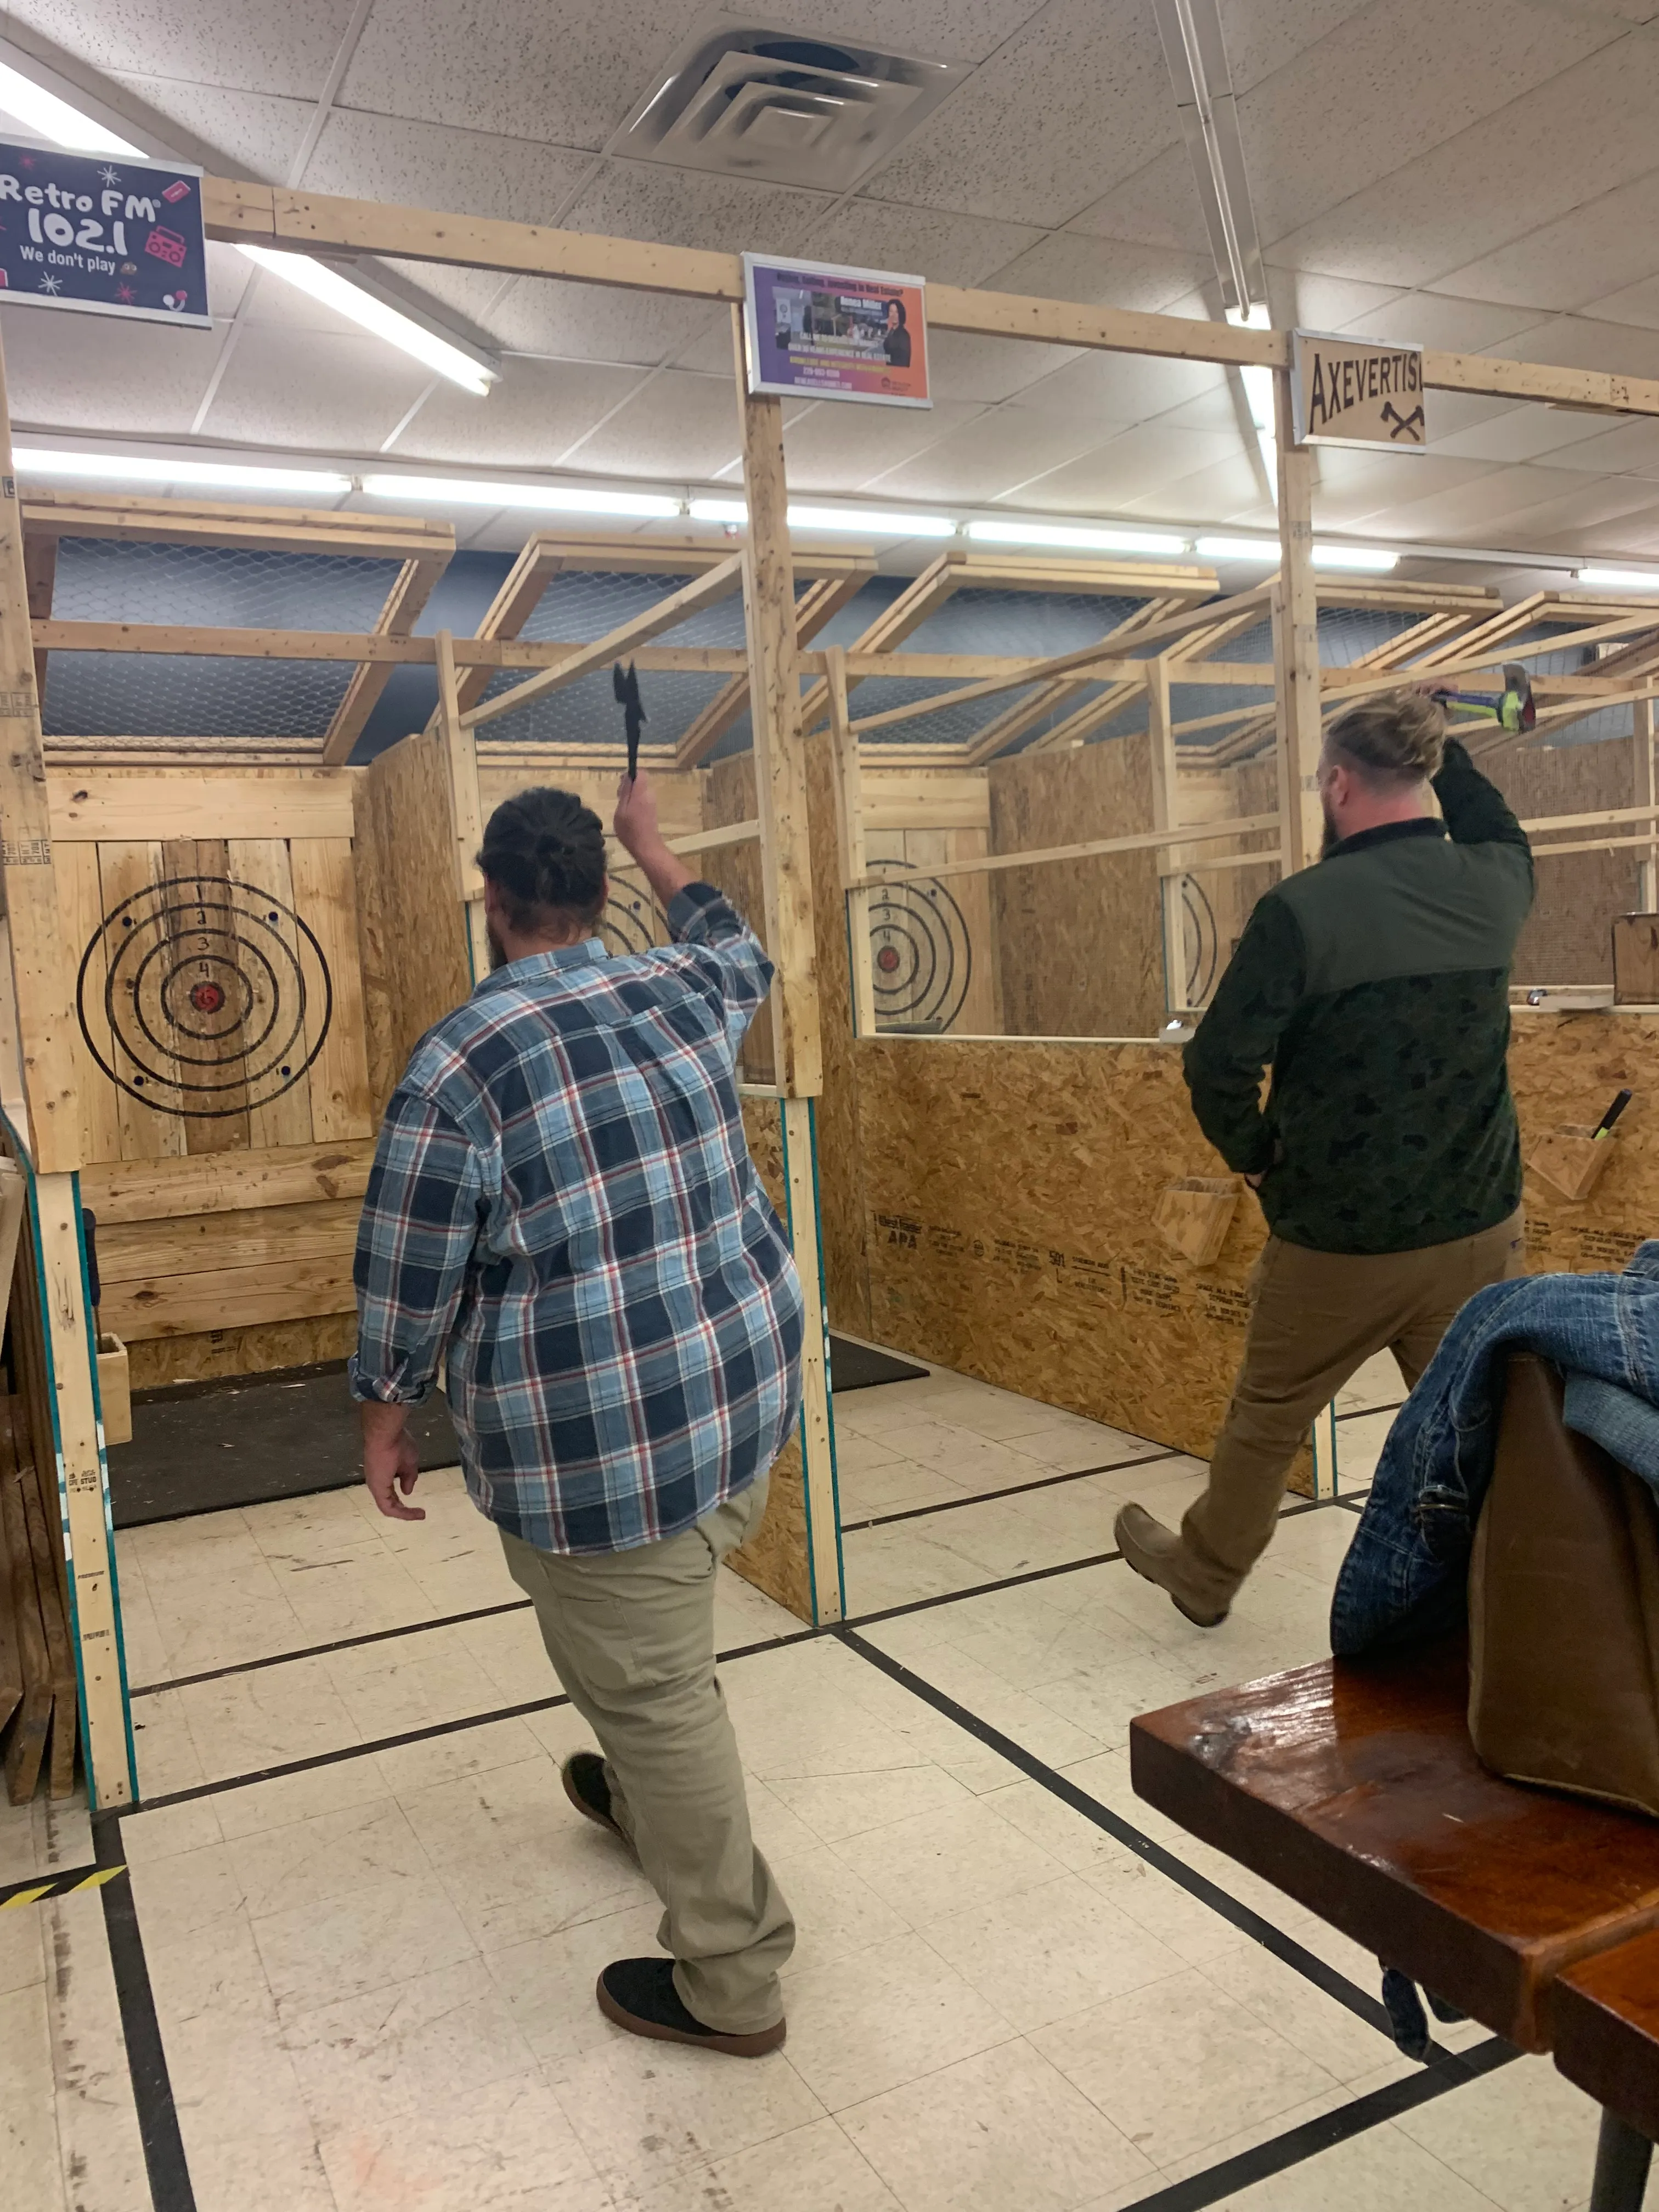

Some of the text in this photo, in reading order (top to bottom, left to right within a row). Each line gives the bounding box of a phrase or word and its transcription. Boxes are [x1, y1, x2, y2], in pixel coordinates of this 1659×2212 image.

[0, 174, 156, 222] Retro FM
[28, 208, 128, 256] 102.1
[20, 245, 116, 275] We don't play
[196, 910, 207, 925] 2
[883, 908, 891, 921] 3
[197, 936, 210, 951] 3
[199, 962, 210, 978] 4
[888, 1230, 917, 1249] APA
[81, 1476, 97, 1485] STUD
